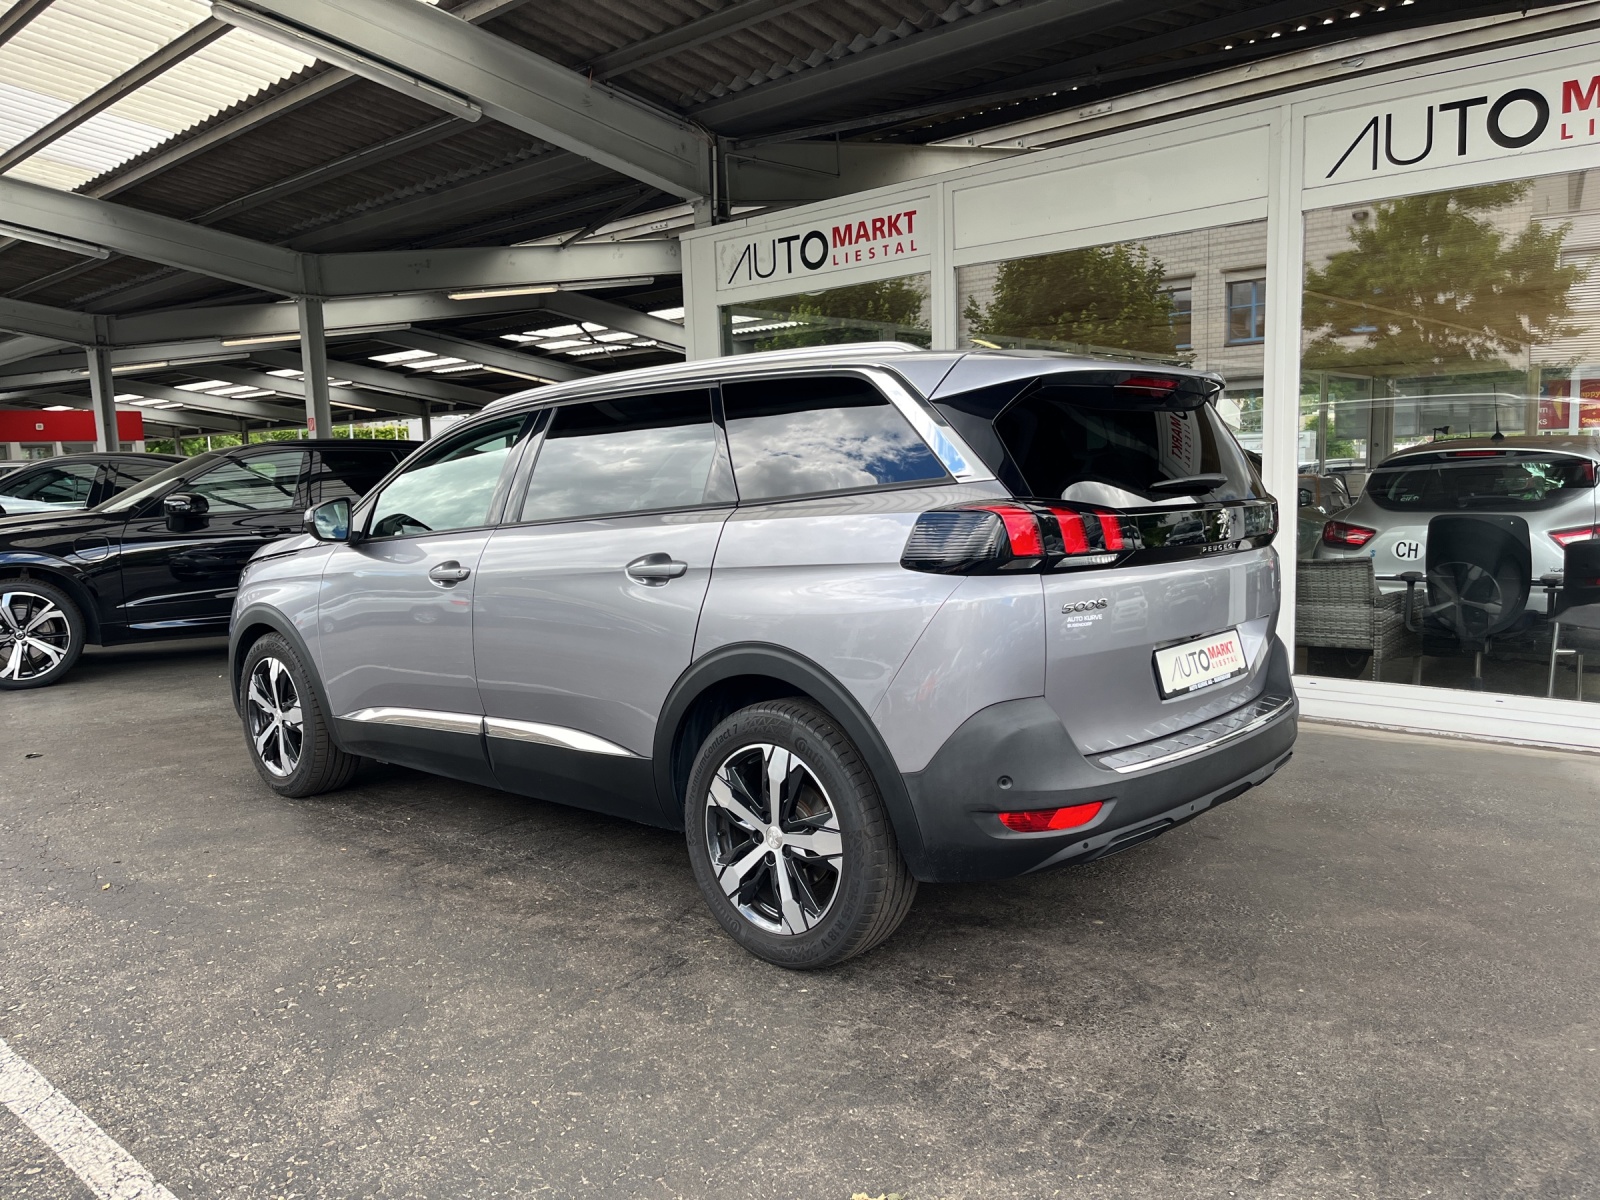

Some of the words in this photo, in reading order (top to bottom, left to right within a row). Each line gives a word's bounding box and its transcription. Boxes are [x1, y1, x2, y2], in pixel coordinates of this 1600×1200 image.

[1325, 87, 1550, 179] AUTO
[728, 230, 829, 284] AUTO
[832, 210, 917, 249] MARKT
[833, 240, 917, 266] LIESTAL
[1202, 542, 1237, 552] PEUGEOT
[1395, 541, 1419, 559] CH
[1061, 598, 1108, 615] 5008
[1172, 649, 1210, 682] AUTO
[1207, 641, 1234, 659] MARKT
[1212, 655, 1238, 668] LIESTAL
